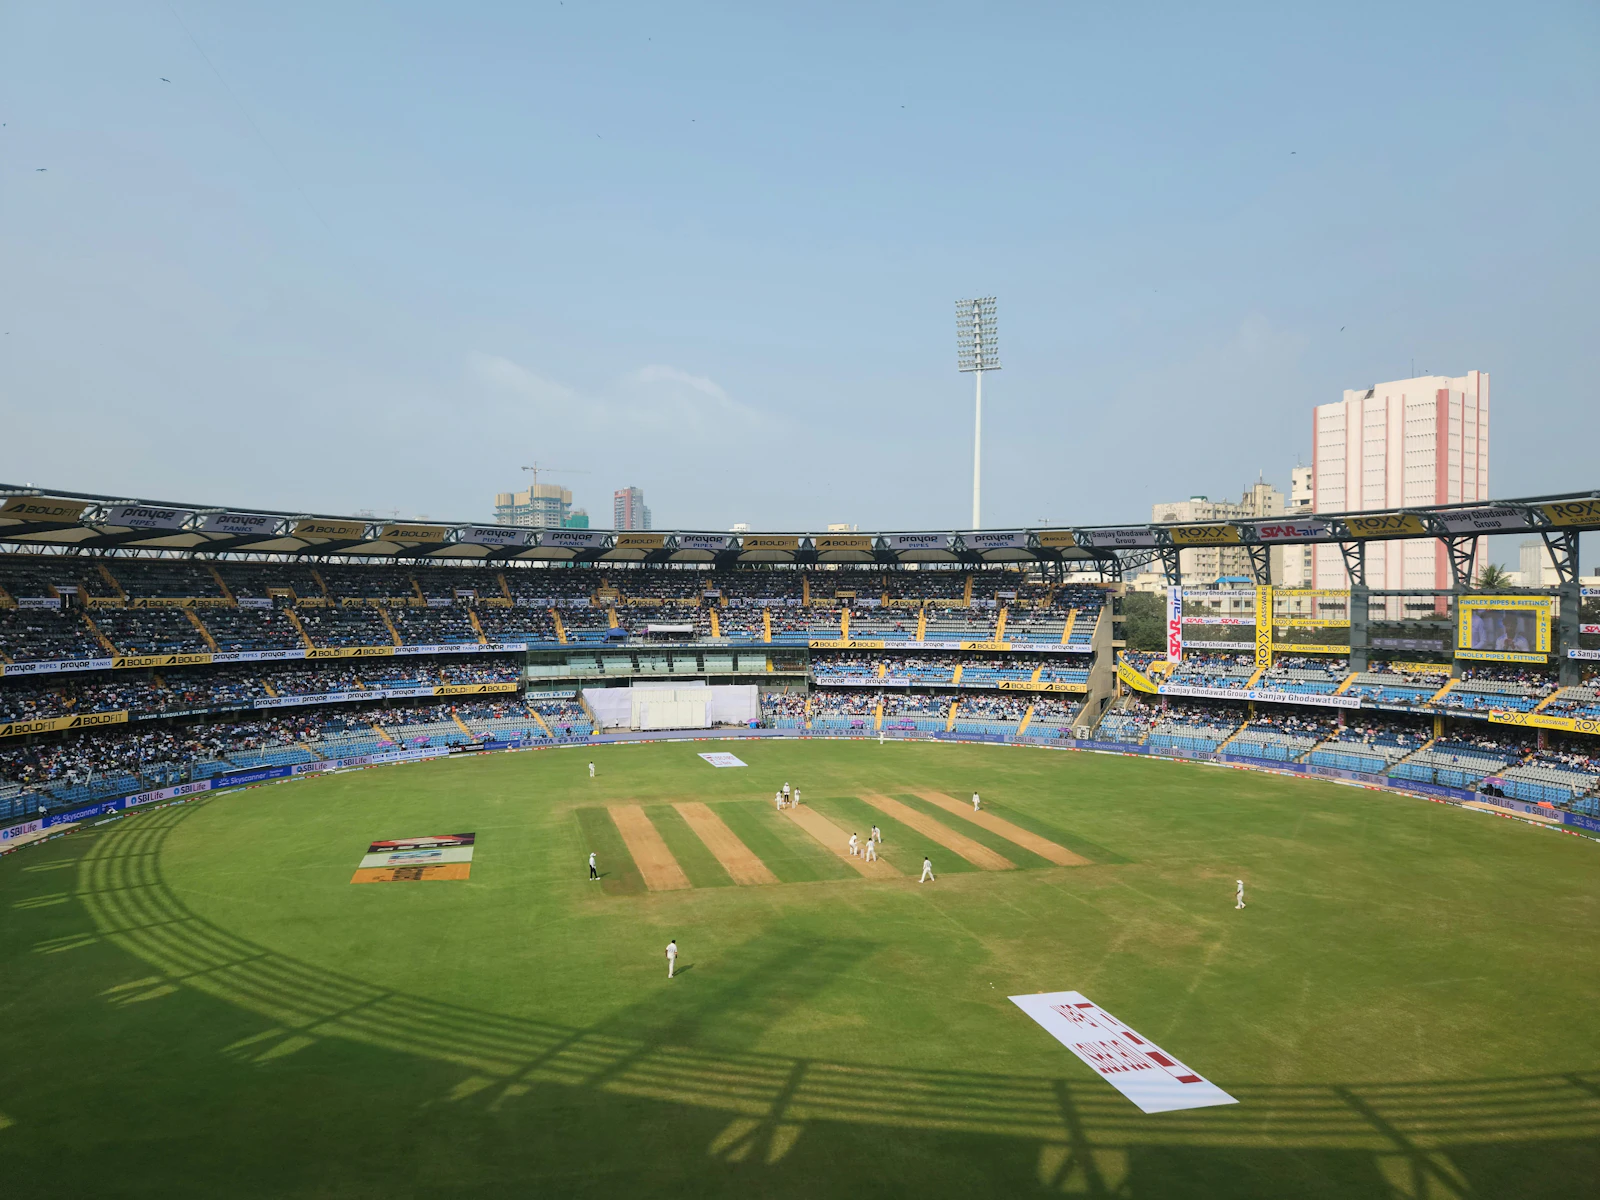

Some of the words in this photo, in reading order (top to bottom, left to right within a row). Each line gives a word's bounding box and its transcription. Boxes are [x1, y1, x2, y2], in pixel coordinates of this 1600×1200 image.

[25, 505, 80, 516] BOLDFIT
[120, 507, 176, 520] prayag
[1441, 513, 1471, 522] Sanjay
[1471, 508, 1518, 519] Ghodawat
[129, 519, 157, 527] PIPES
[216, 516, 266, 526] prayag
[1353, 516, 1412, 530] ROXX
[1474, 520, 1502, 528] Group
[315, 526, 361, 535] BOLDFIT
[474, 529, 516, 538] prayag
[1178, 527, 1228, 538] ROXX
[1261, 525, 1300, 538] STAR
[552, 533, 593, 541] prayag
[1169, 615, 1181, 661] STAR
[1259, 630, 1269, 666] ROXX
[127, 657, 162, 666] BOLDFIT
[1168, 686, 1190, 695] Sanjay
[1192, 688, 1226, 696] Ghodawat
[1227, 690, 1248, 698] Group
[1258, 693, 1287, 701] Sanjay
[1288, 694, 1331, 704] Ghodawat
[1333, 698, 1358, 707] Group
[15, 721, 56, 733] BOLDFIT
[84, 714, 123, 725] BOLDFIT
[1534, 718, 1569, 727] GLASSWARE
[355, 757, 367, 765] Life
[315, 763, 327, 771] Life
[231, 773, 266, 784] Skyscanner
[1330, 769, 1342, 778] Life
[1371, 775, 1383, 784] Life
[180, 786, 192, 794] SBI
[193, 783, 206, 792] Life
[1408, 782, 1446, 795] Skyscanner
[138, 794, 149, 803] SBI
[150, 791, 163, 801] Life
[1488, 797, 1501, 806] SBI
[1502, 799, 1514, 809] Life
[62, 807, 98, 822] Skyscanner
[1532, 807, 1545, 816] SBI
[1546, 808, 1559, 819] Life
[10, 828, 22, 838] SBI
[23, 824, 36, 834] Life
